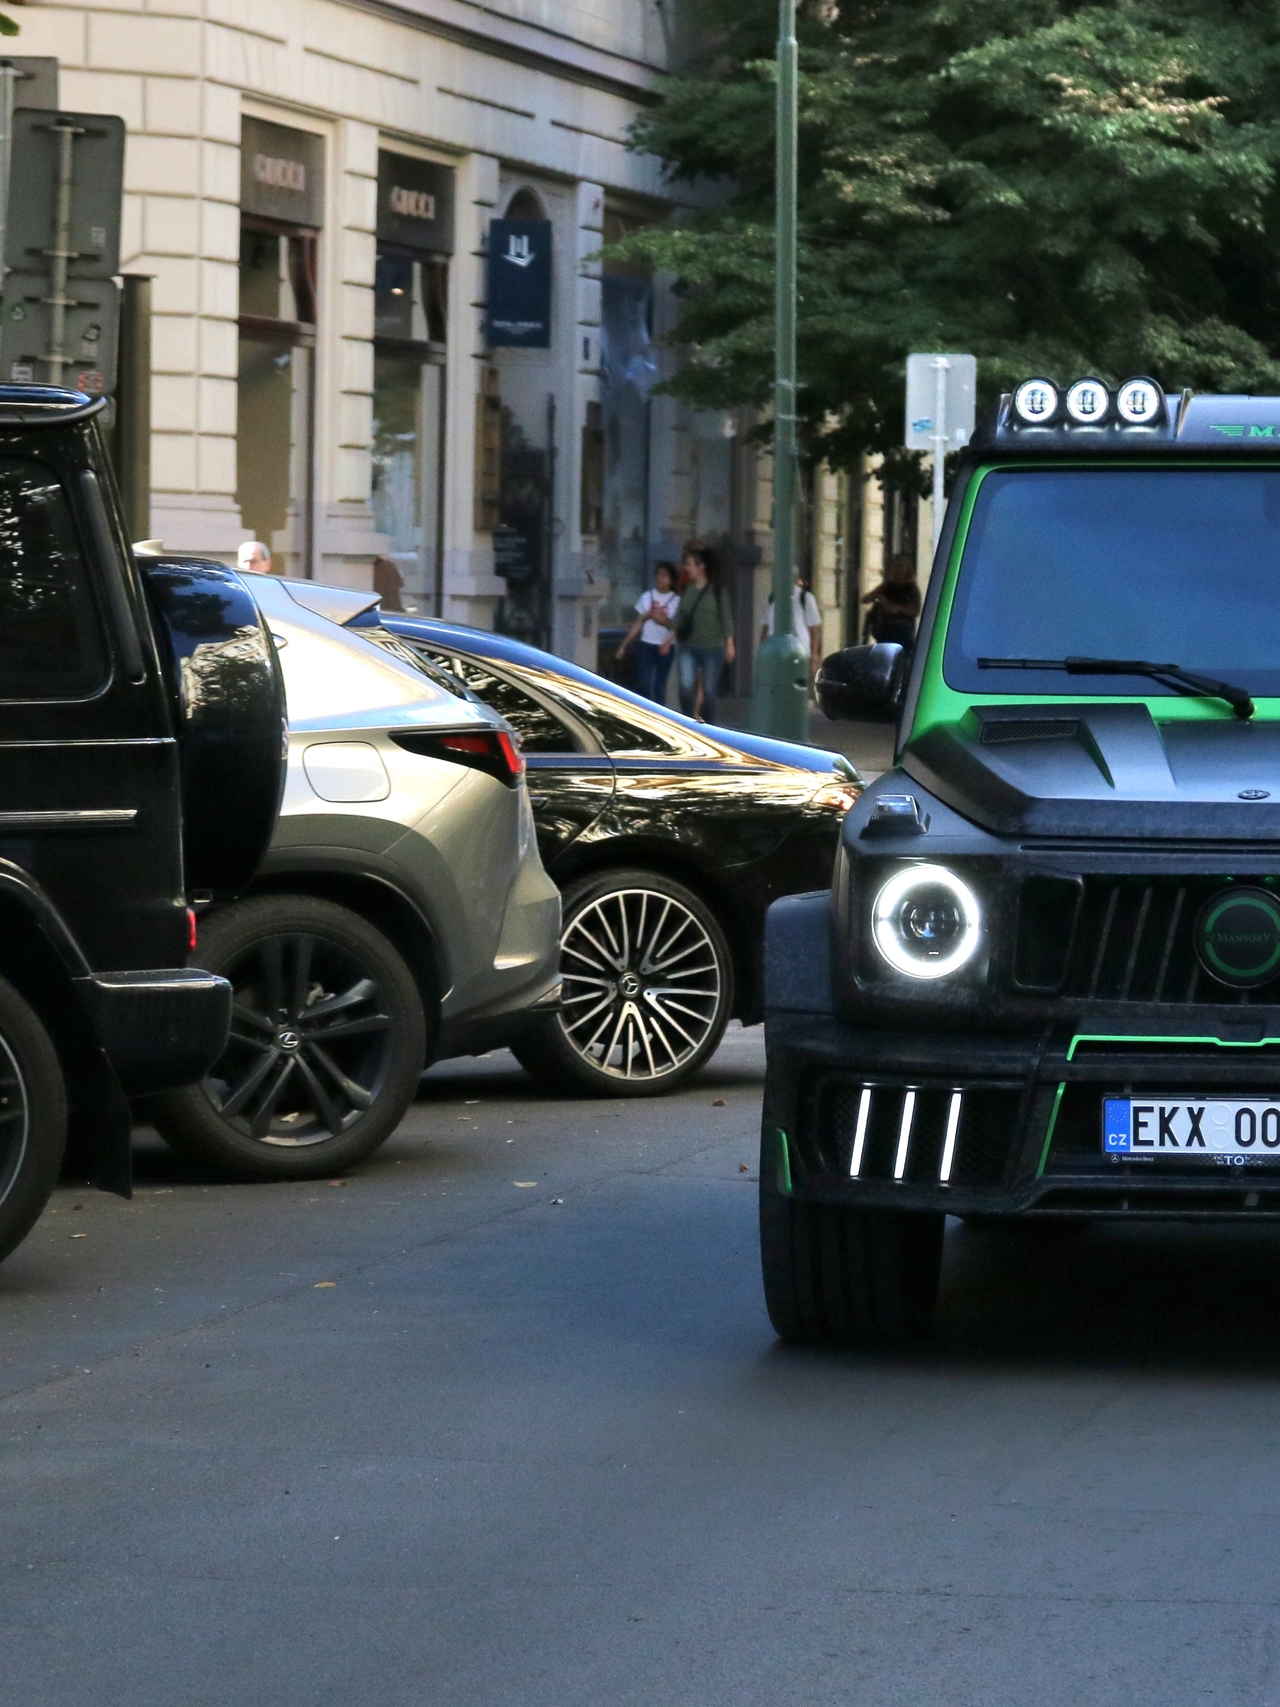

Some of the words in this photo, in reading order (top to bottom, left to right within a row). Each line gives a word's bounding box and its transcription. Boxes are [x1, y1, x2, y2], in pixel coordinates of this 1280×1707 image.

[390, 186, 435, 220] GUCCI
[1217, 933, 1271, 943] MANSORY
[1132, 1106, 1206, 1147] EKX
[1108, 1133, 1127, 1146] CZ
